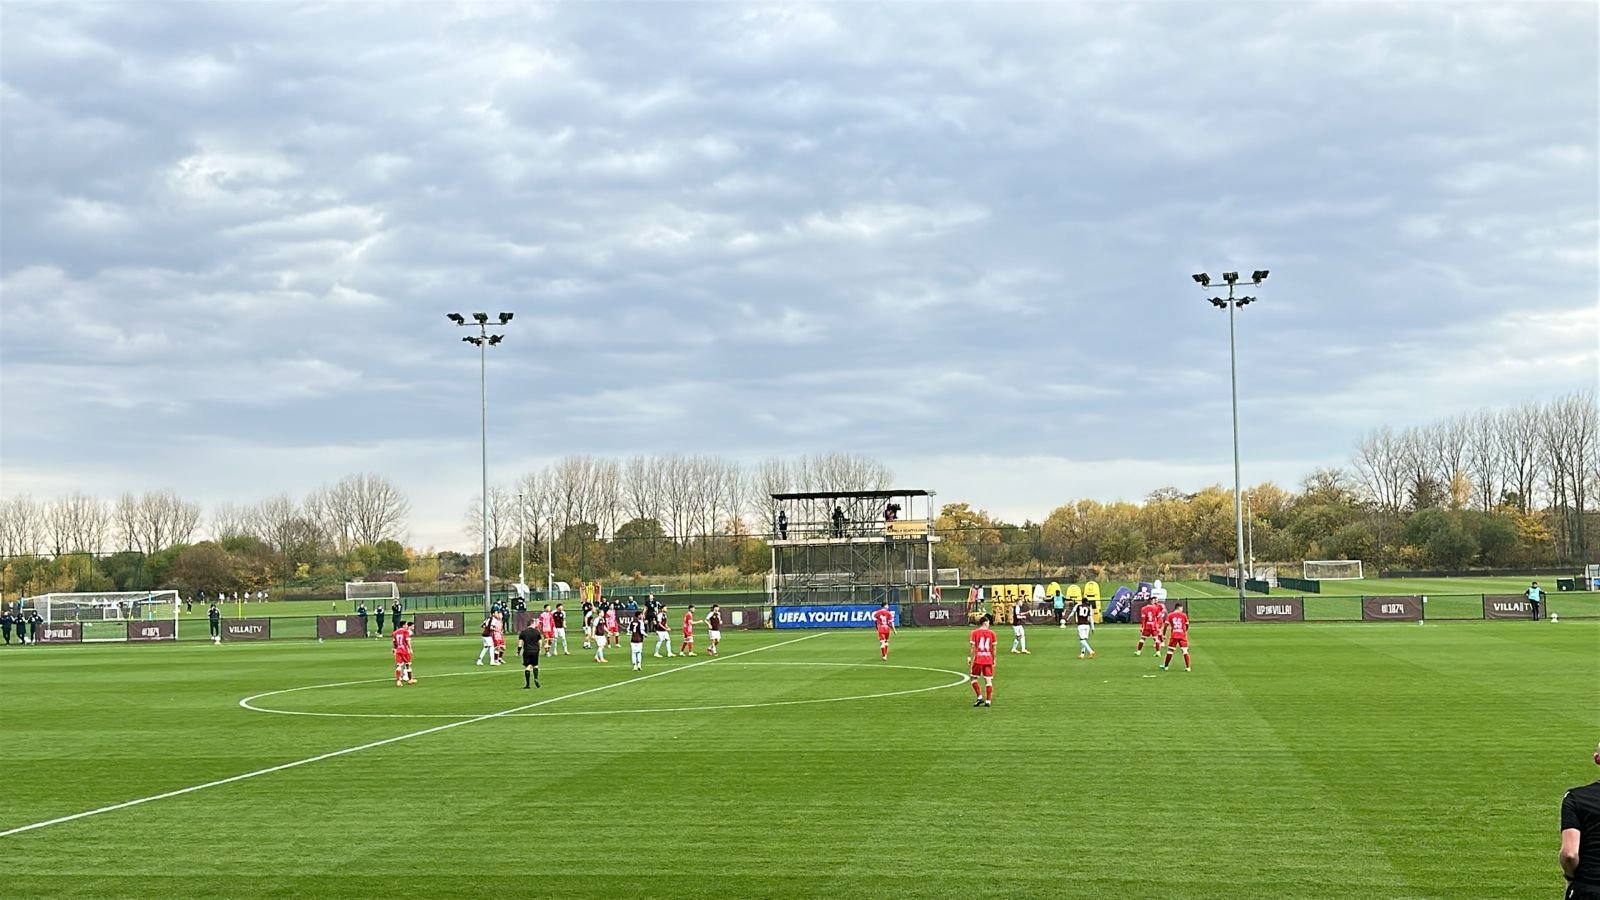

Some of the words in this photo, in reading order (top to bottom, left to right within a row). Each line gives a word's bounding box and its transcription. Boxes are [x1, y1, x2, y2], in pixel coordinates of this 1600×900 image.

[1080, 606, 1089, 617] 10
[1494, 603, 1520, 611] VILLA
[779, 612, 806, 622] UEFA
[808, 612, 848, 622] YOUTH
[632, 622, 638, 632] 7
[978, 636, 990, 651] 44
